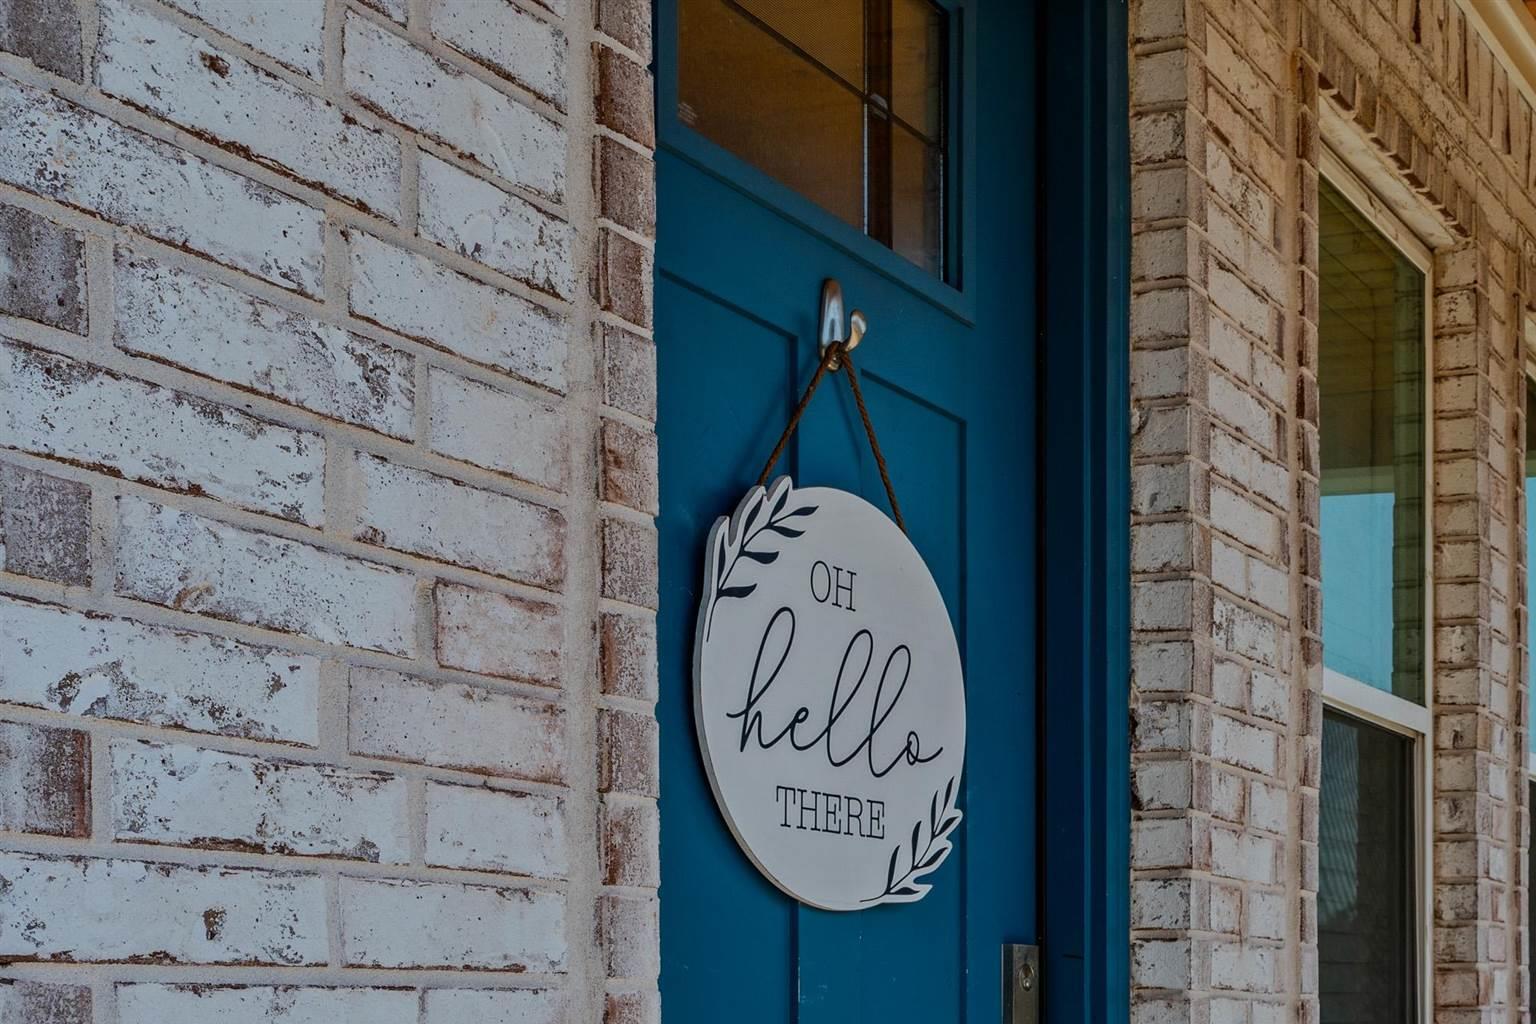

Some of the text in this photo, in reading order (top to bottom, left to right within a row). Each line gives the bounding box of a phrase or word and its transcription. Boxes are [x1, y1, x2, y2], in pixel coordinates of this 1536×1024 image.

[809, 560, 857, 612] OH
[726, 606, 944, 778] hello
[775, 785, 886, 840] THERE
